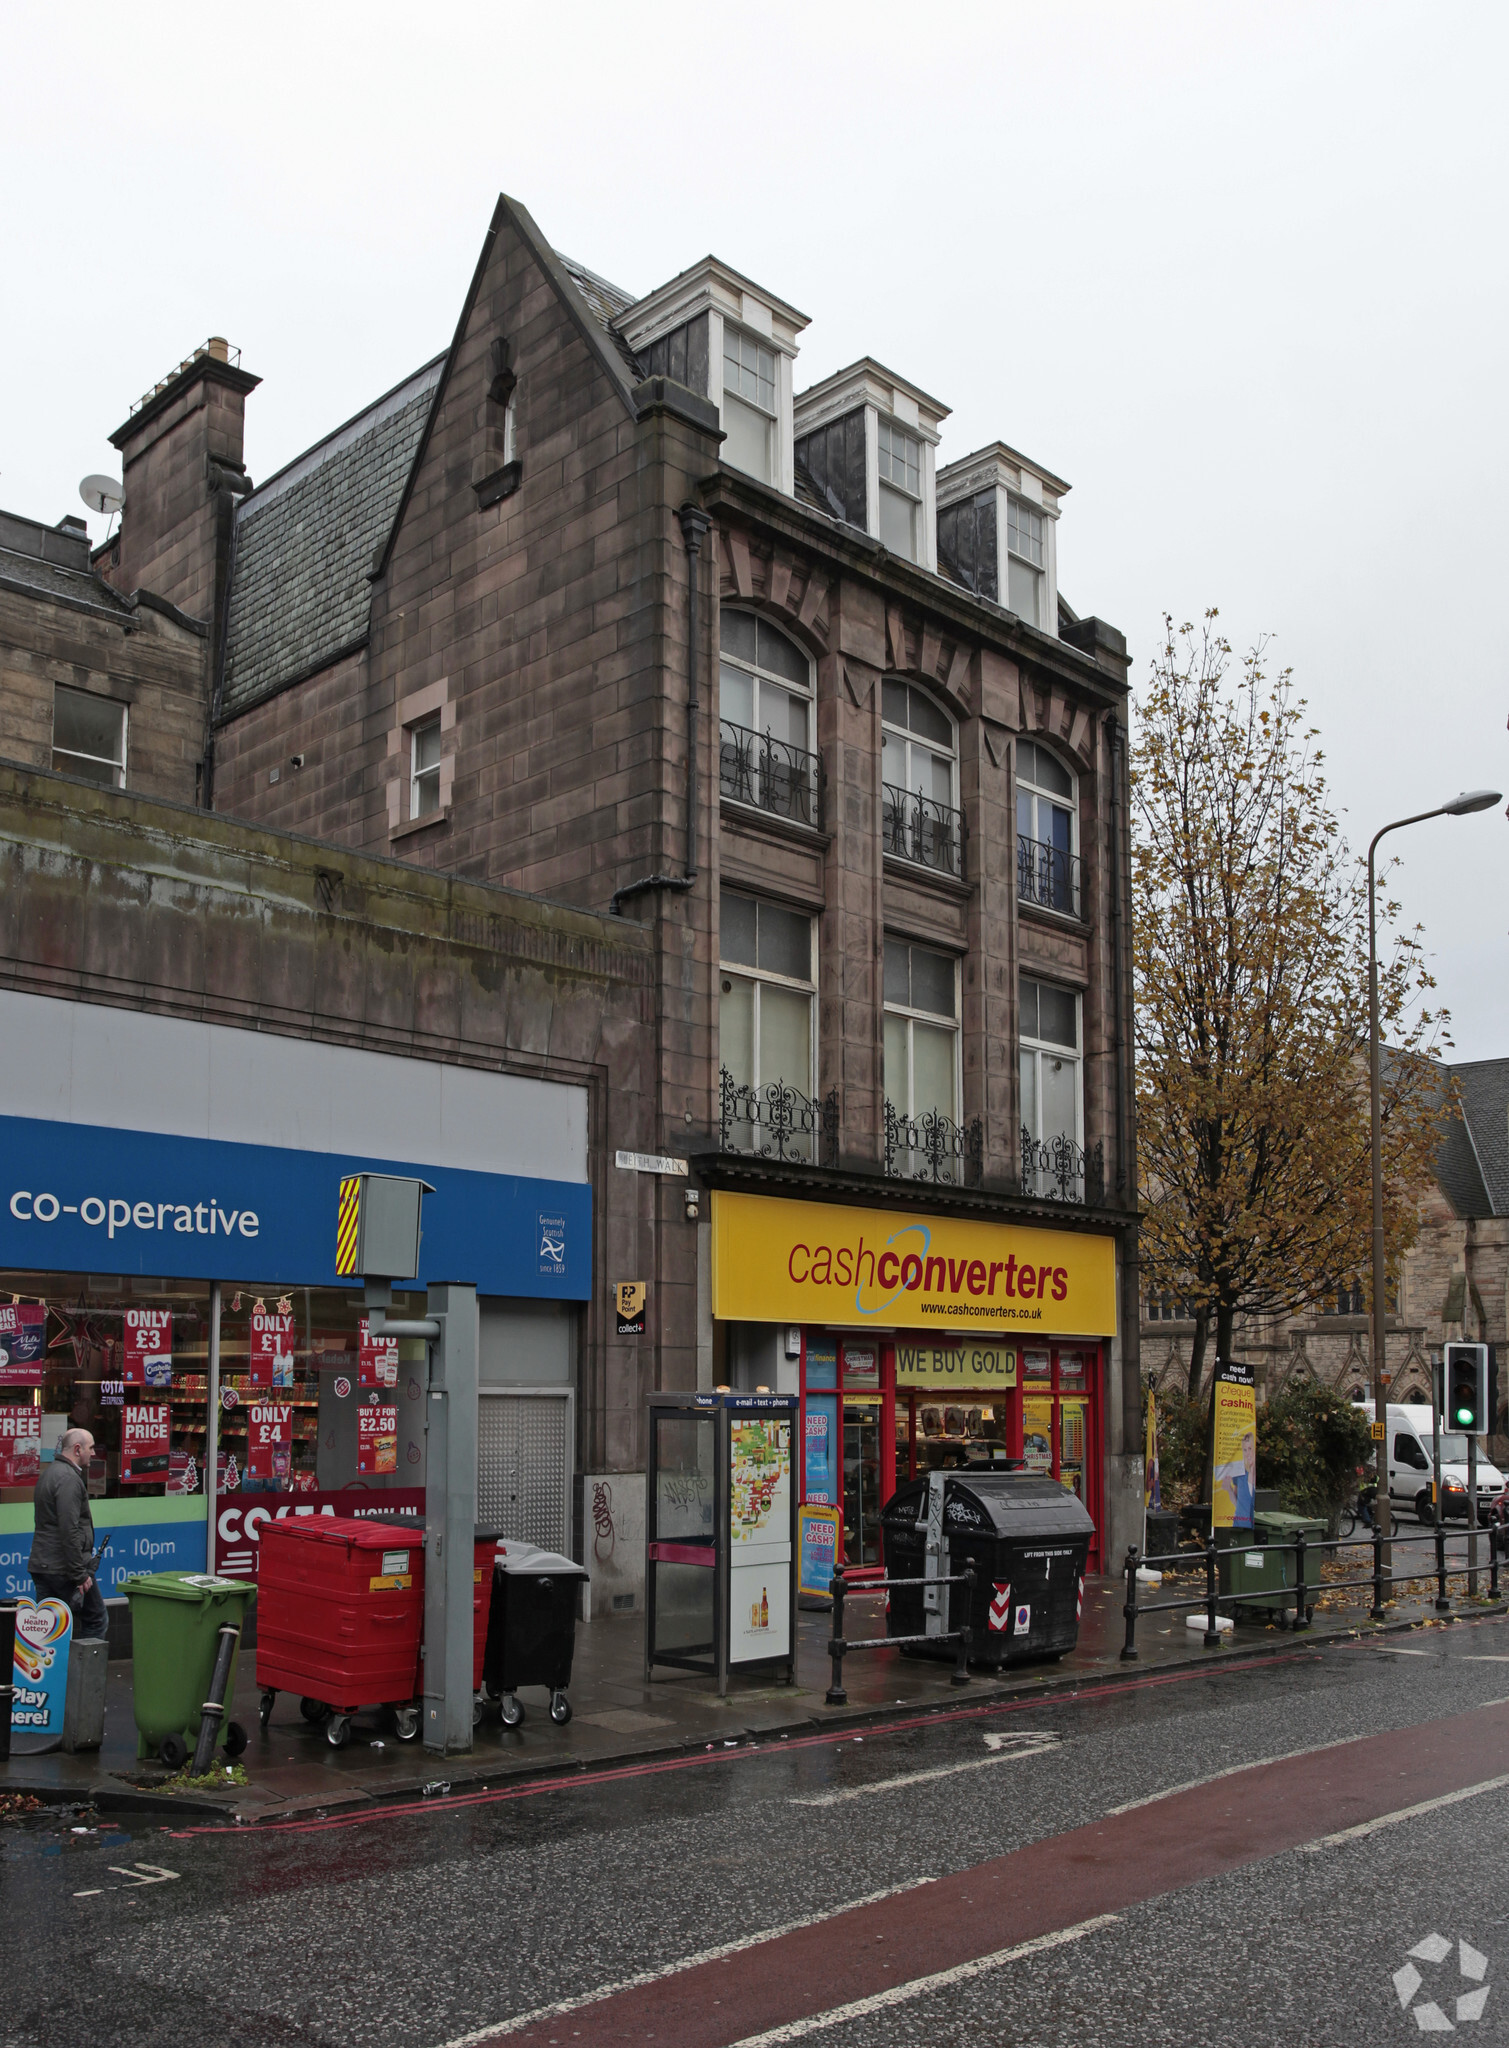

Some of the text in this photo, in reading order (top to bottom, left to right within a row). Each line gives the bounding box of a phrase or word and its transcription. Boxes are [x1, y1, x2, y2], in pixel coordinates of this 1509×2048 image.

[656, 1159, 684, 1173] WALK
[9, 1190, 260, 1239] co-operative
[539, 1214, 566, 1229] Genuinely
[542, 1226, 564, 1238] Scottish
[553, 1263, 566, 1274] 1859
[0, 1308, 15, 1322] IG
[920, 1303, 1042, 1320] www.cashconverters.co.uk
[127, 1310, 171, 1328] ONLY
[253, 1314, 293, 1332] ONLY
[136, 1329, 161, 1349] £3
[261, 1333, 282, 1352] £1
[898, 1348, 1015, 1374] WE BUY GOLD
[1221, 1372, 1237, 1382] cash
[1229, 1365, 1246, 1375] need
[101, 1380, 125, 1394] COSTA
[1220, 1385, 1251, 1397] cheque
[735, 1398, 789, 1408] e-mail text phone
[17, 1408, 32, 1416] GET
[126, 1406, 168, 1423] HALF
[251, 1406, 290, 1423] ONLY
[360, 1407, 396, 1416] BUY 2 FOR
[360, 1417, 396, 1432] £2.50
[807, 1416, 827, 1425] NEED
[125, 1424, 168, 1439] PRICE
[259, 1425, 282, 1443] £4
[805, 1426, 827, 1436] CASH?
[808, 1493, 828, 1503] NEED
[810, 1522, 834, 1534] NEED
[806, 1533, 834, 1545] CASH?
[134, 1538, 176, 1560] 10pm
[23, 1618, 49, 1626] Health
[22, 1625, 49, 1634] Lottery
[12, 1687, 48, 1708] Play
